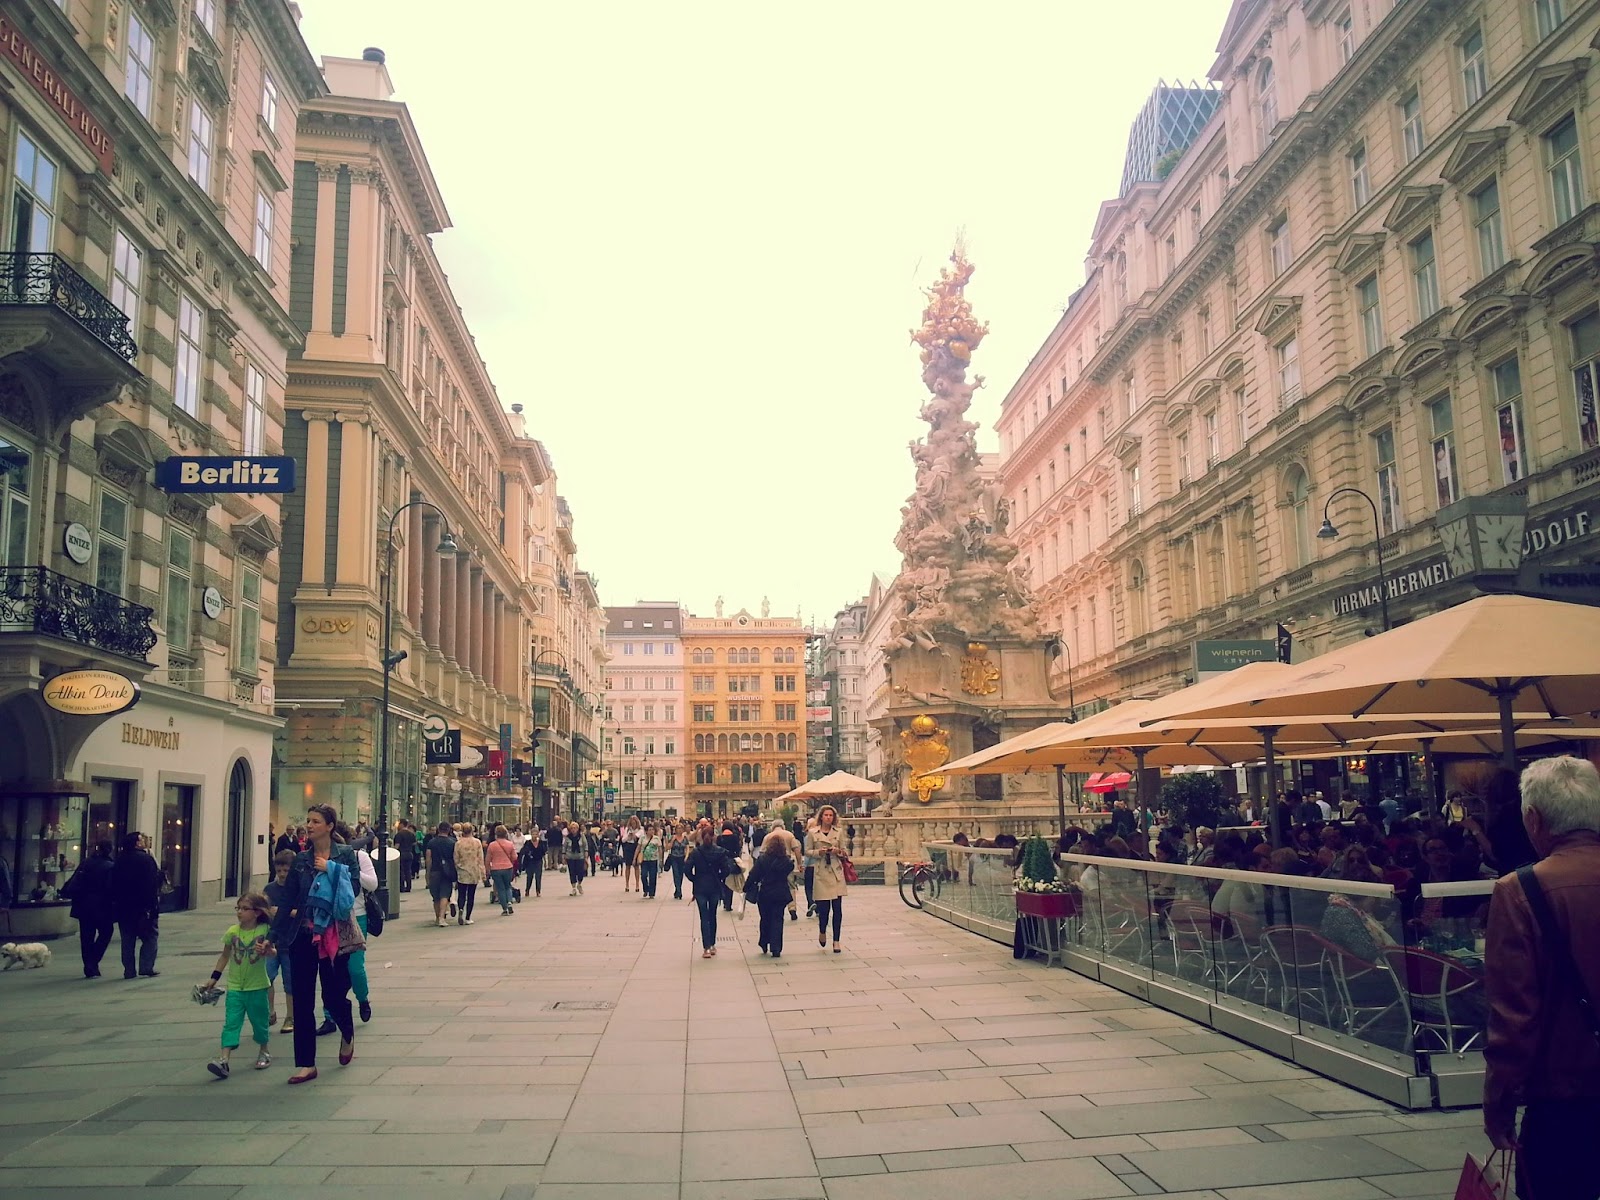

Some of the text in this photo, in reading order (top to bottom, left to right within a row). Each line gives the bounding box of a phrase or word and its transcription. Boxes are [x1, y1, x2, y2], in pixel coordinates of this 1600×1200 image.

[180, 460, 279, 484] Berlitz
[68, 534, 90, 551] KNIZE
[1332, 511, 1592, 616] UHRMACHERMEI UDOLF
[1211, 648, 1262, 657] wienerin
[47, 684, 129, 700] Albin Denk
[121, 722, 180, 750] HELDWEIN
[432, 736, 453, 754] GR
